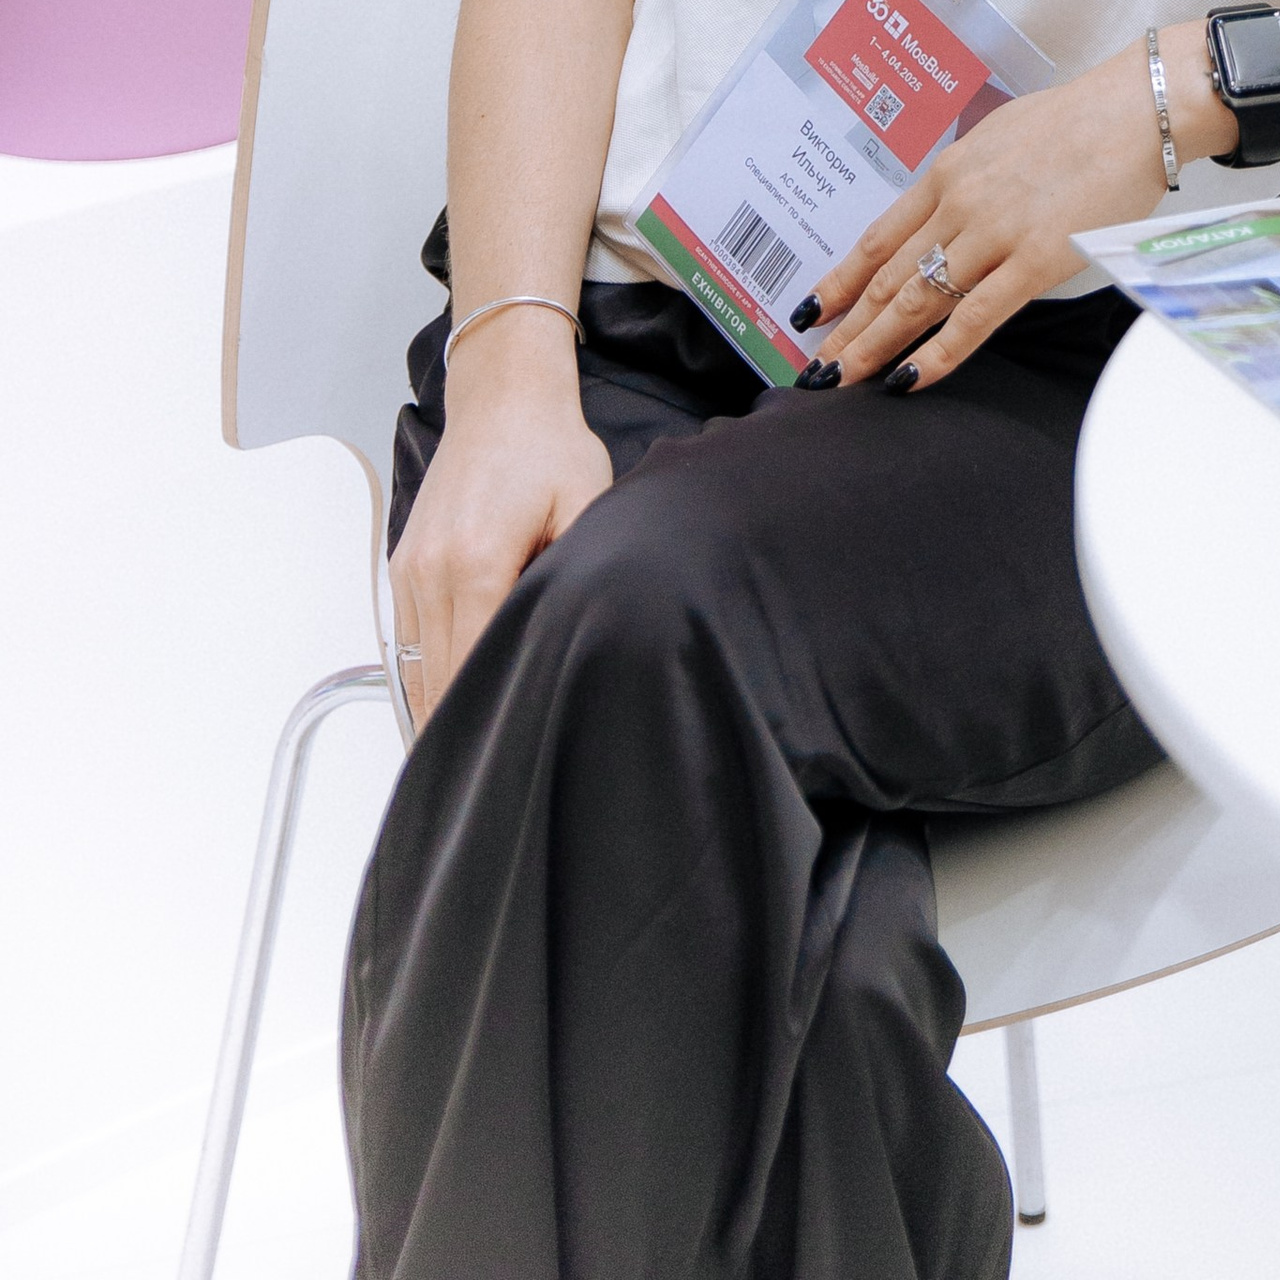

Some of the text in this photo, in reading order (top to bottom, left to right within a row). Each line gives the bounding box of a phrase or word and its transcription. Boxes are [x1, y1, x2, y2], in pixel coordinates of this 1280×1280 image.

[851, 54, 880, 85] MosBuild
[881, 49, 923, 92] 4.04.2025
[901, 33, 959, 94] MosBuild
[791, 145, 838, 199] Ильчук
[800, 119, 857, 185] Виктория
[744, 157, 834, 258] Специалист по закупкам
[779, 172, 819, 213] АС МАРТ
[1151, 226, 1254, 252] КАТАЛОГ
[691, 271, 747, 336] EXHIBITOR
